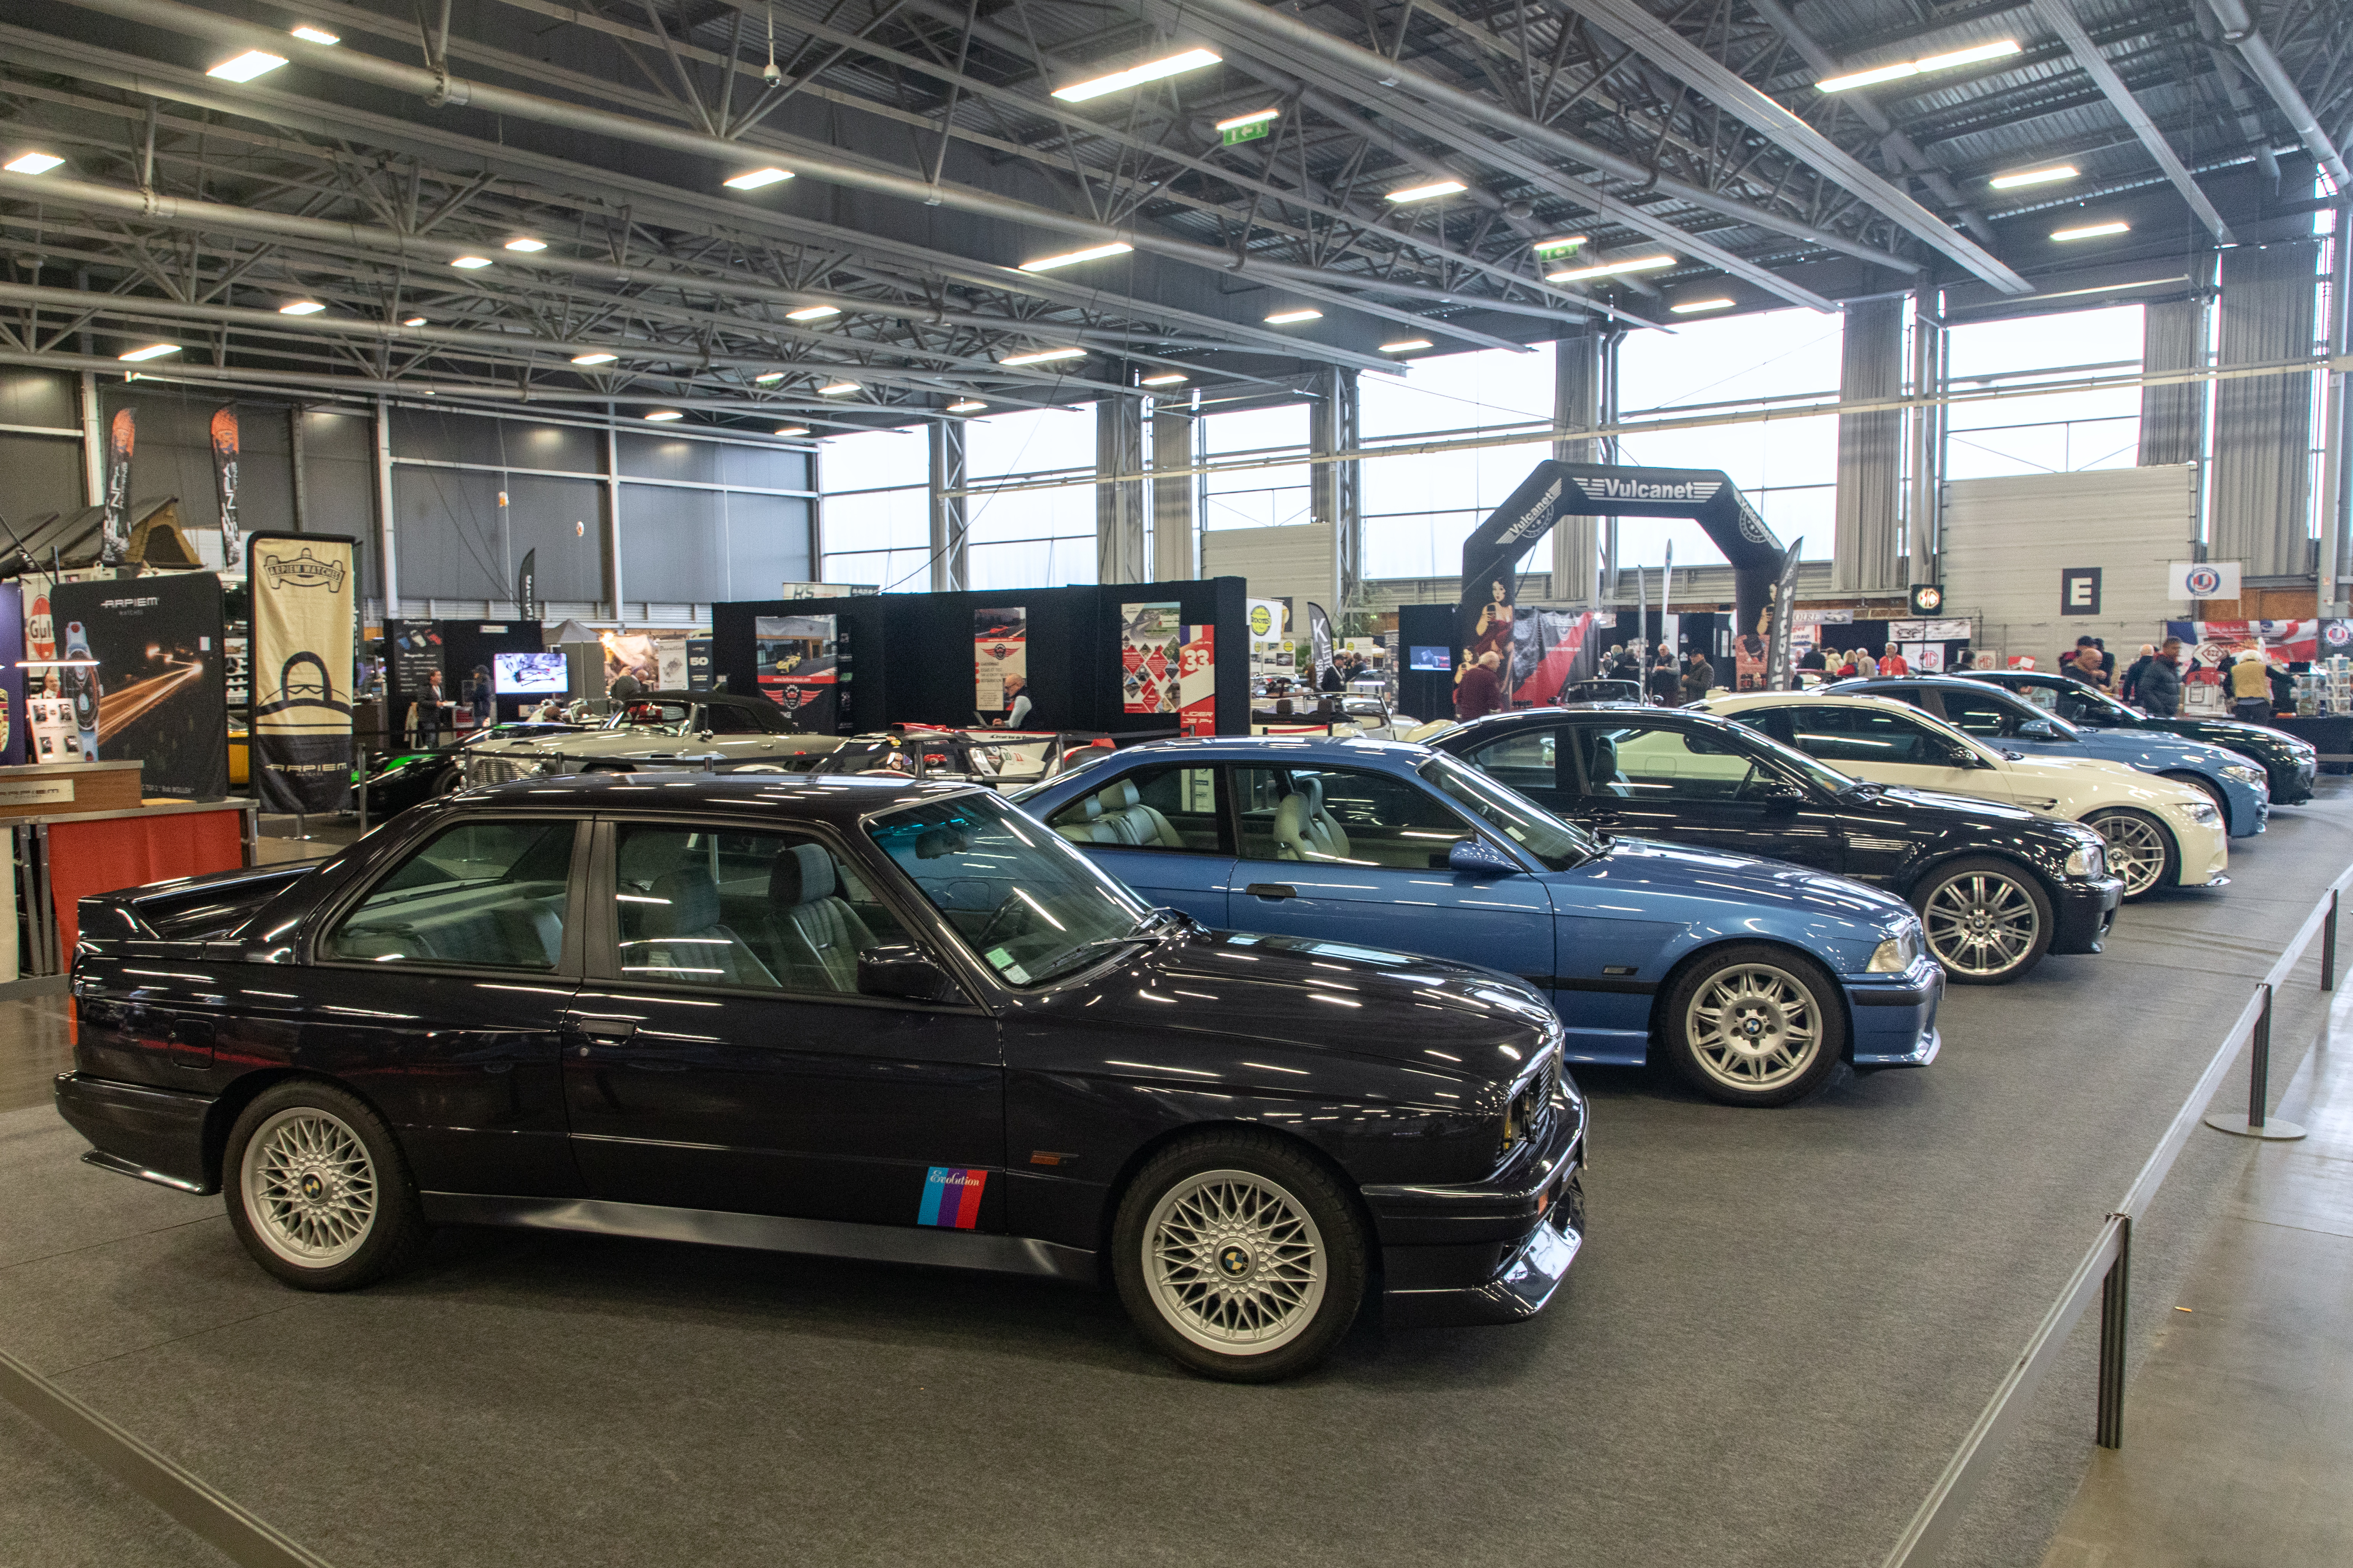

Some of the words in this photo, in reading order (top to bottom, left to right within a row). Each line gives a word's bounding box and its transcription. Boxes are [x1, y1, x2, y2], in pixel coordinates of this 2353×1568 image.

[223, 463, 236, 509] NPA
[1605, 479, 1693, 500] Vulcanet
[1509, 490, 1554, 534] Vulcanet
[1741, 499, 1774, 541] Vulcanet
[304, 565, 340, 579] WATCHES
[2070, 577, 2092, 606] E
[101, 597, 159, 608] ARPIEM
[30, 619, 52, 639] Gul
[1312, 618, 1328, 642] K
[690, 657, 709, 666] 50
[1184, 649, 1209, 671] 33
[1920, 652, 1937, 666] MG
[1980, 656, 1992, 668] MG
[1003, 752, 1012, 760] 10
[1014, 752, 1024, 761] 11
[265, 762, 347, 772] ARPIEM
[930, 1170, 980, 1186] Evolution
